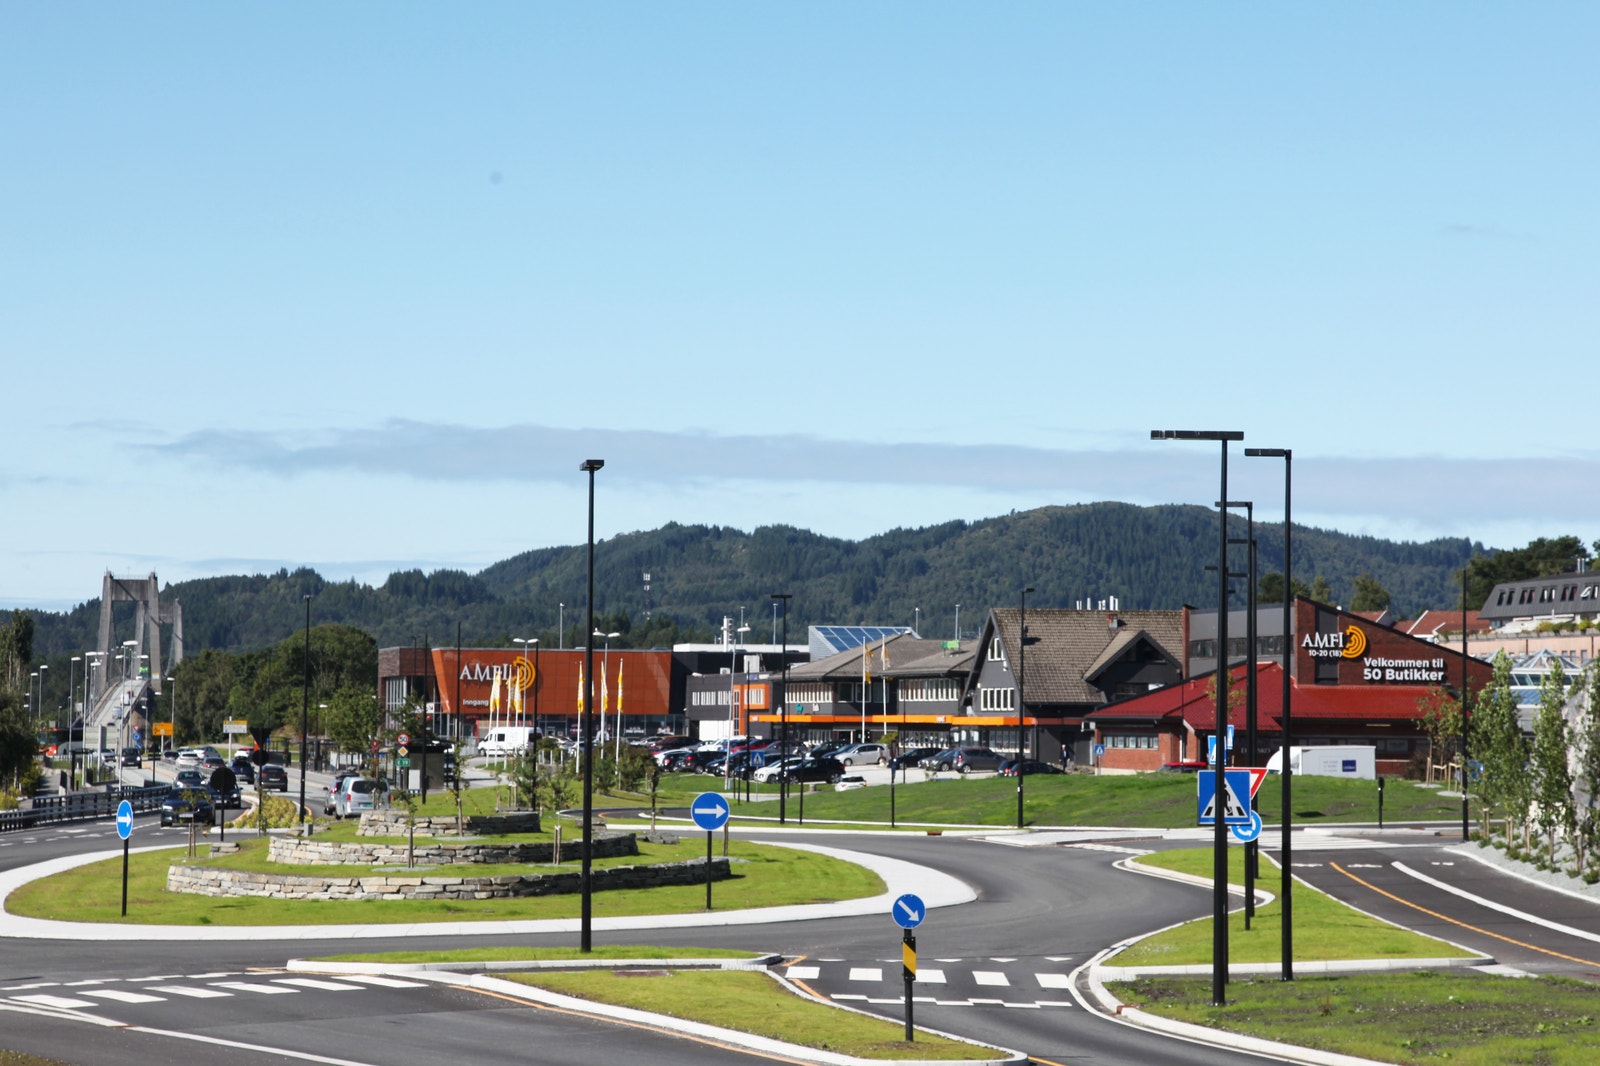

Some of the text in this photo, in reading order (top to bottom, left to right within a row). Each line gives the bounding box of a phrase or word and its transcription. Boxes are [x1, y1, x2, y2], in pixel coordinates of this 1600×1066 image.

[1301, 631, 1344, 648] AMFI
[1308, 649, 1342, 658] 10-20 (18)
[1363, 657, 1444, 668] Velkommen til
[1363, 668, 1444, 681] 50 Butikker
[462, 699, 489, 707] Inngang
